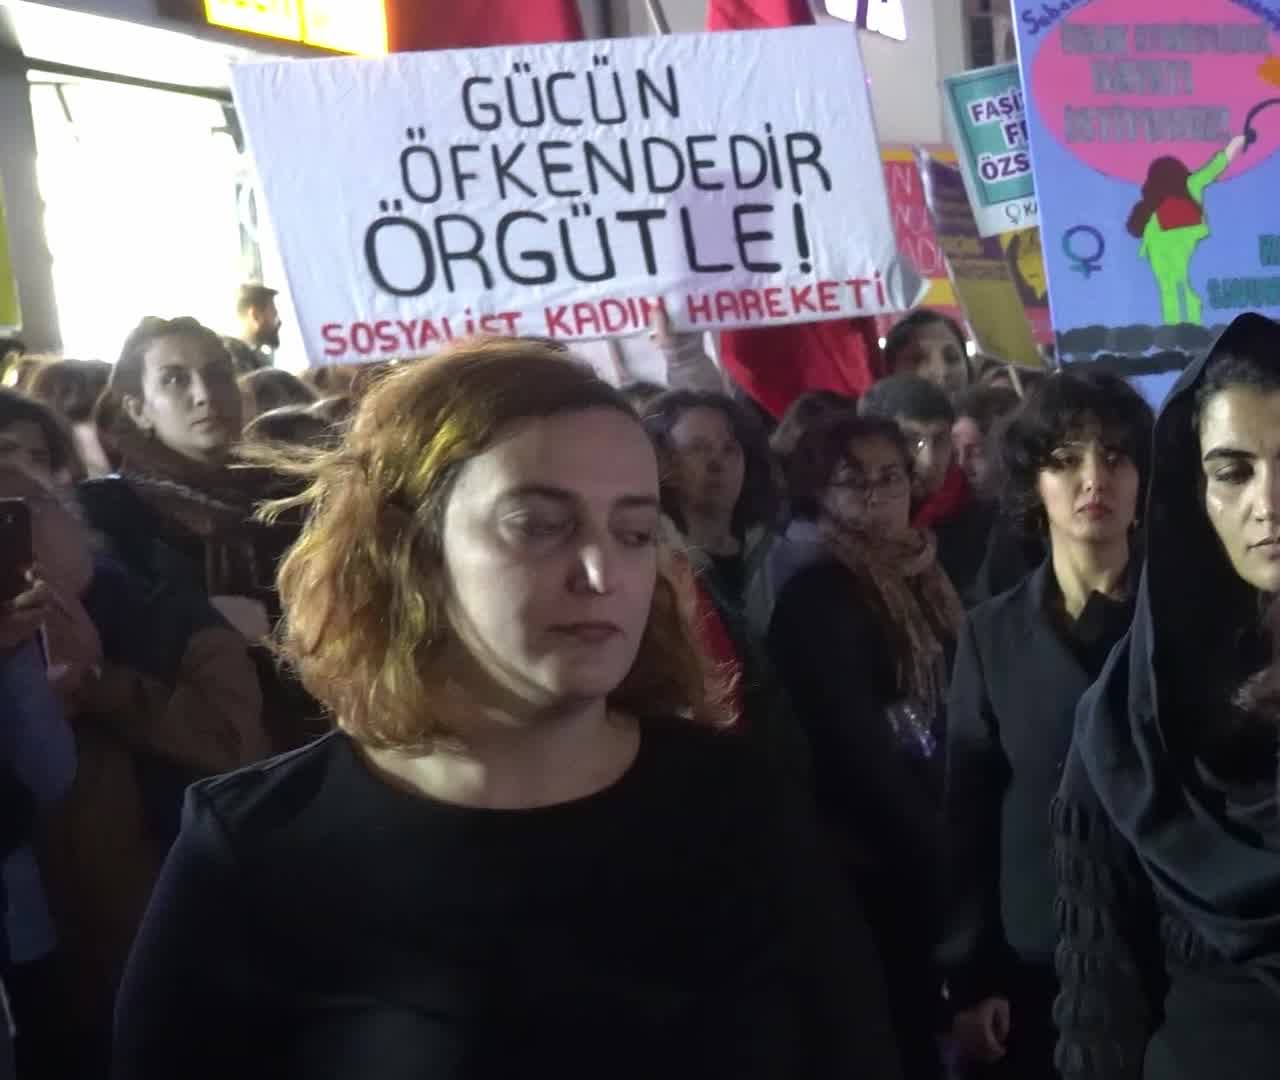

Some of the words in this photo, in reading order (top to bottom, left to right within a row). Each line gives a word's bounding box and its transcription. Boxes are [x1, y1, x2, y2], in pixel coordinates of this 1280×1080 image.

[461, 55, 682, 132] GÜCÜN
[400, 121, 834, 205] ÖFKENDEDİR
[362, 199, 812, 299] ÖRGÜTLE!
[543, 295, 668, 338] KADIN
[687, 270, 888, 325] HAREKETİ
